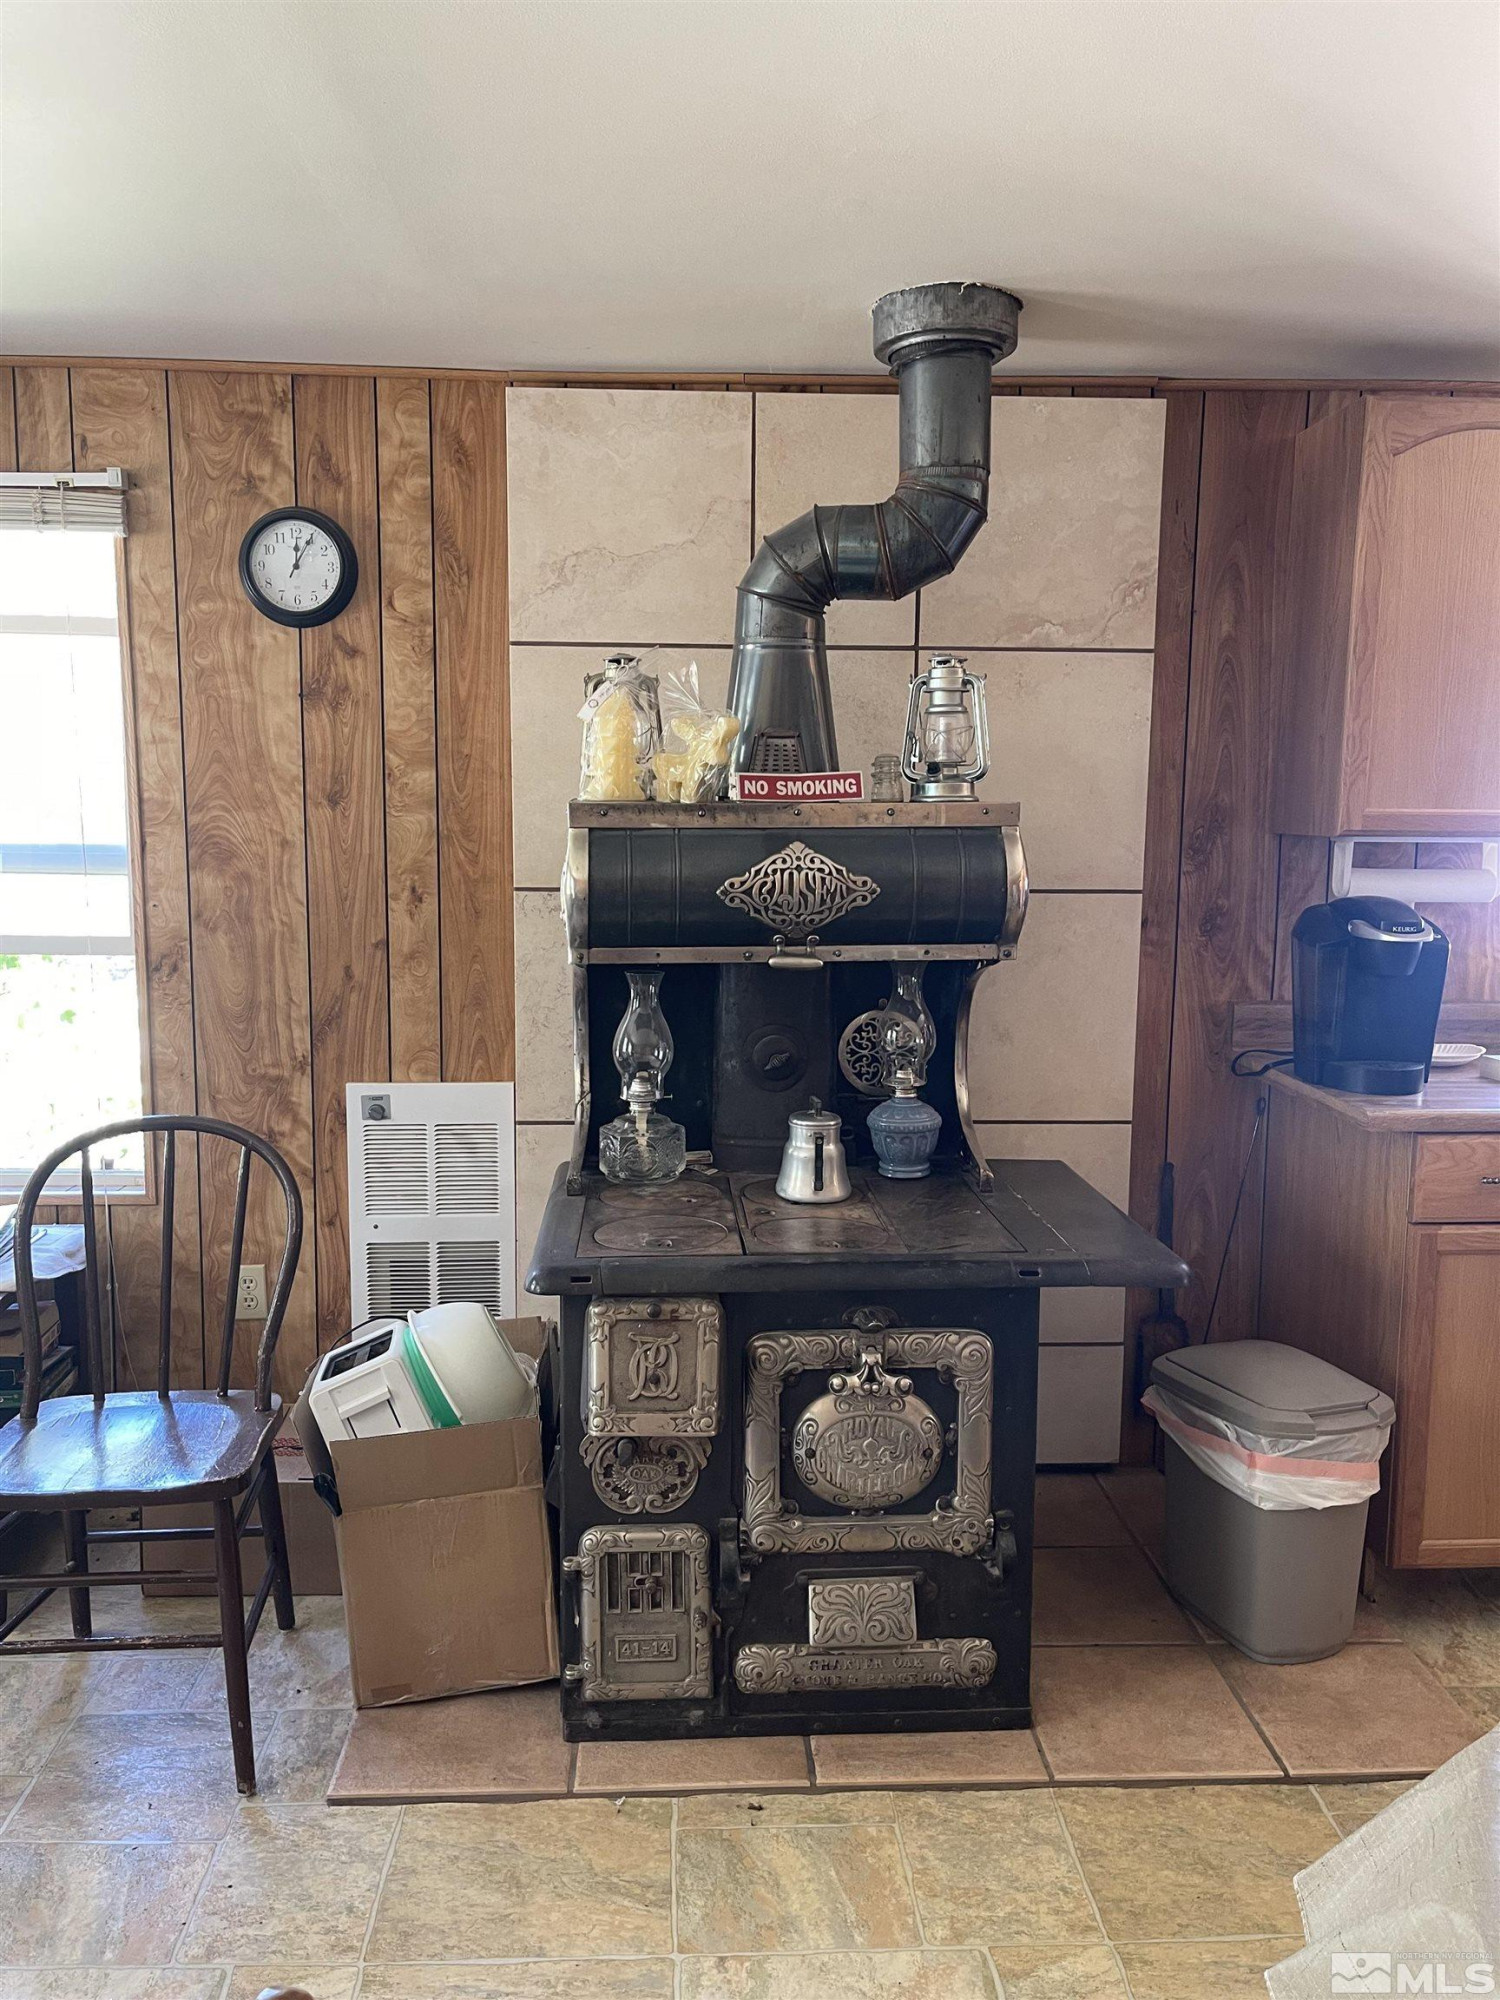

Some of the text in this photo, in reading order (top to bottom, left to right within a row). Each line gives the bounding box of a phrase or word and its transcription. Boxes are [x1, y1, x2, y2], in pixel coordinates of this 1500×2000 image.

[275, 532, 285, 544] 11
[290, 527, 302, 539] 12
[263, 544, 275, 556] 10
[320, 545, 328, 557] 2
[258, 560, 266, 572] 9
[327, 562, 335, 573] 3
[265, 578, 272, 589] 8
[321, 579, 328, 590] 4
[278, 590, 286, 601] 7
[294, 594, 301, 606] 6
[310, 591, 318, 602] 5
[744, 778, 857, 796] NO SMOKING
[843, 1416, 896, 1443] ROYAL
[632, 1468, 658, 1480] OAK
[621, 1641, 671, 1656] 41-14
[893, 1657, 924, 1670] OAK
